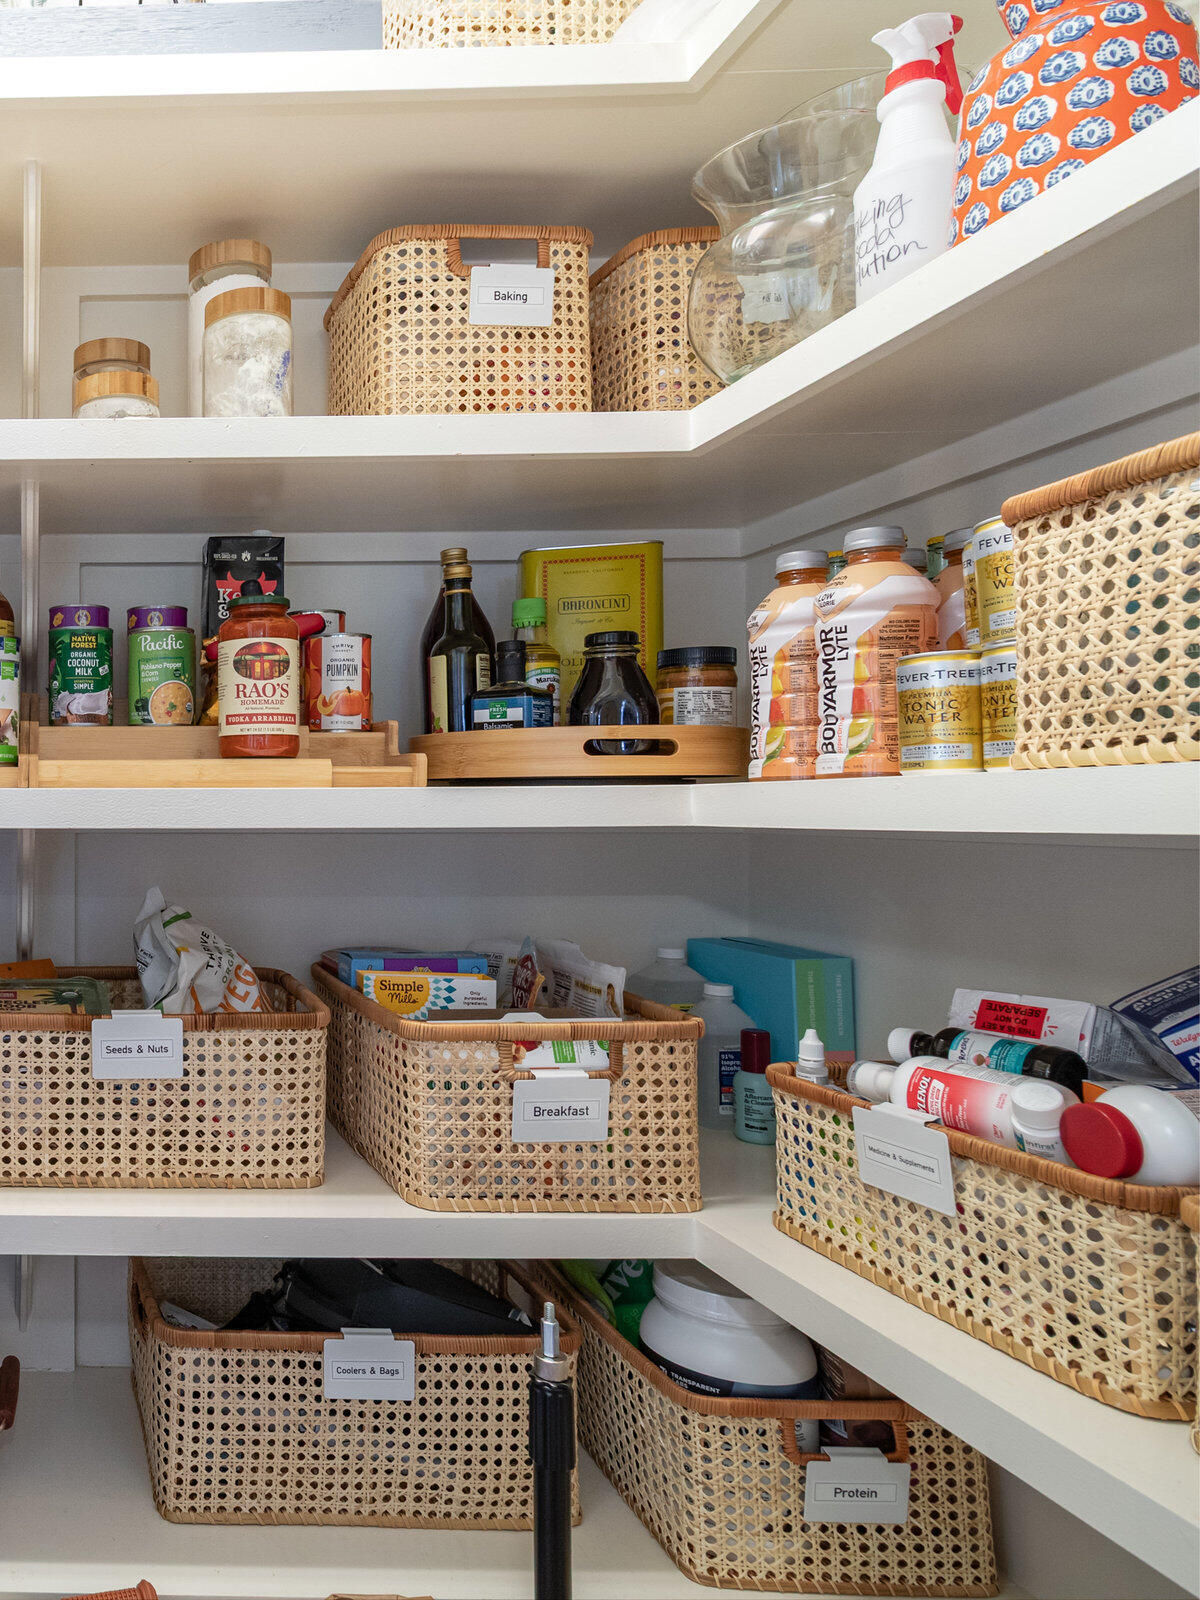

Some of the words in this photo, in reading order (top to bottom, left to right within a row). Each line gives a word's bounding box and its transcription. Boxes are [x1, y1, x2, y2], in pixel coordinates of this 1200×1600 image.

[494, 290, 528, 305] Baking
[562, 597, 626, 612] BARONCINI
[71, 641, 97, 649] FOREST
[137, 634, 185, 651] Pacific
[835, 624, 849, 661] LYTE
[67, 659, 100, 667] COCONUT
[141, 662, 162, 670] Poblano
[163, 662, 182, 670] Pepper
[758, 645, 769, 677] LYTE
[75, 667, 93, 676] MILK
[326, 664, 359, 677] PUMPKIN
[820, 626, 839, 755] BODYARMOR
[907, 690, 953, 700] PREMIUM
[904, 699, 959, 712] TONIC
[228, 715, 250, 723] VODKA
[904, 711, 962, 725] WATER
[379, 979, 424, 994] Simple
[387, 992, 418, 1005] Mills
[985, 1002, 1042, 1018] SEPARATE
[994, 1014, 1012, 1023] NOT
[1014, 1017, 1028, 1026] DO
[981, 1021, 998, 1030] SET
[998, 1024, 1006, 1032] A
[1007, 1025, 1016, 1033] IS
[1017, 1027, 1036, 1037] THIS
[105, 1044, 133, 1055] Seeds
[136, 1044, 144, 1055] &
[147, 1044, 169, 1055] Nuts
[533, 1104, 589, 1117] Breakfast
[868, 1145, 891, 1159] Medicine
[892, 1153, 897, 1161] &
[899, 1156, 935, 1174] Supplements
[336, 1366, 367, 1377] Coolers
[370, 1366, 376, 1377] &
[379, 1366, 400, 1378] Bags
[670, 1370, 721, 1394] TRANSPARENT
[834, 1487, 878, 1499] Protein
